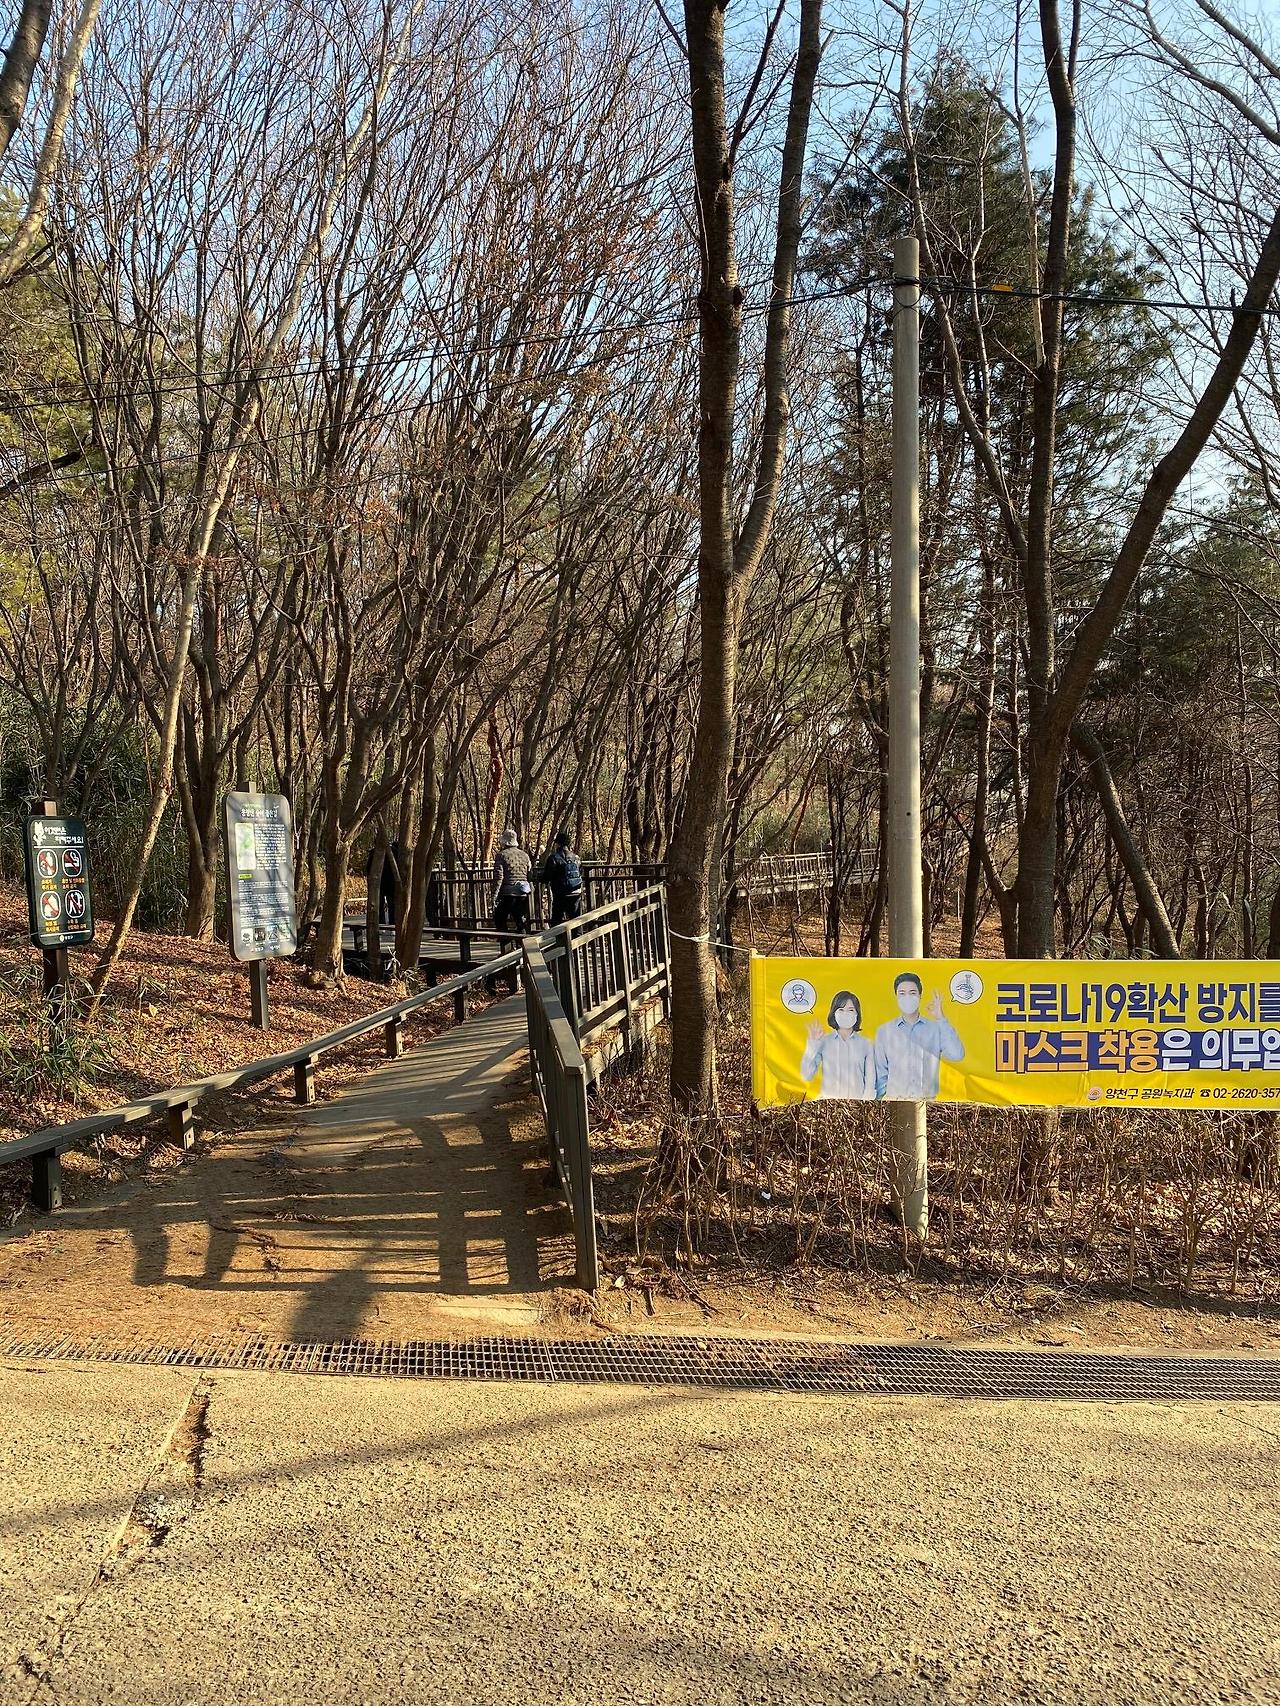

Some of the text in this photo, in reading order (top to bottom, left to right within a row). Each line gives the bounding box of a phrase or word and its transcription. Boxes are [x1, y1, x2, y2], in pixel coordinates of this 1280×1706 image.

[996, 982, 1280, 1024] 코로나19확산 방지를
[995, 1030, 1089, 1073] 마스크
[1098, 1029, 1193, 1073] 착용은
[1105, 1088, 1139, 1100] 양천구
[1141, 1087, 1195, 1099] 공원녹지과
